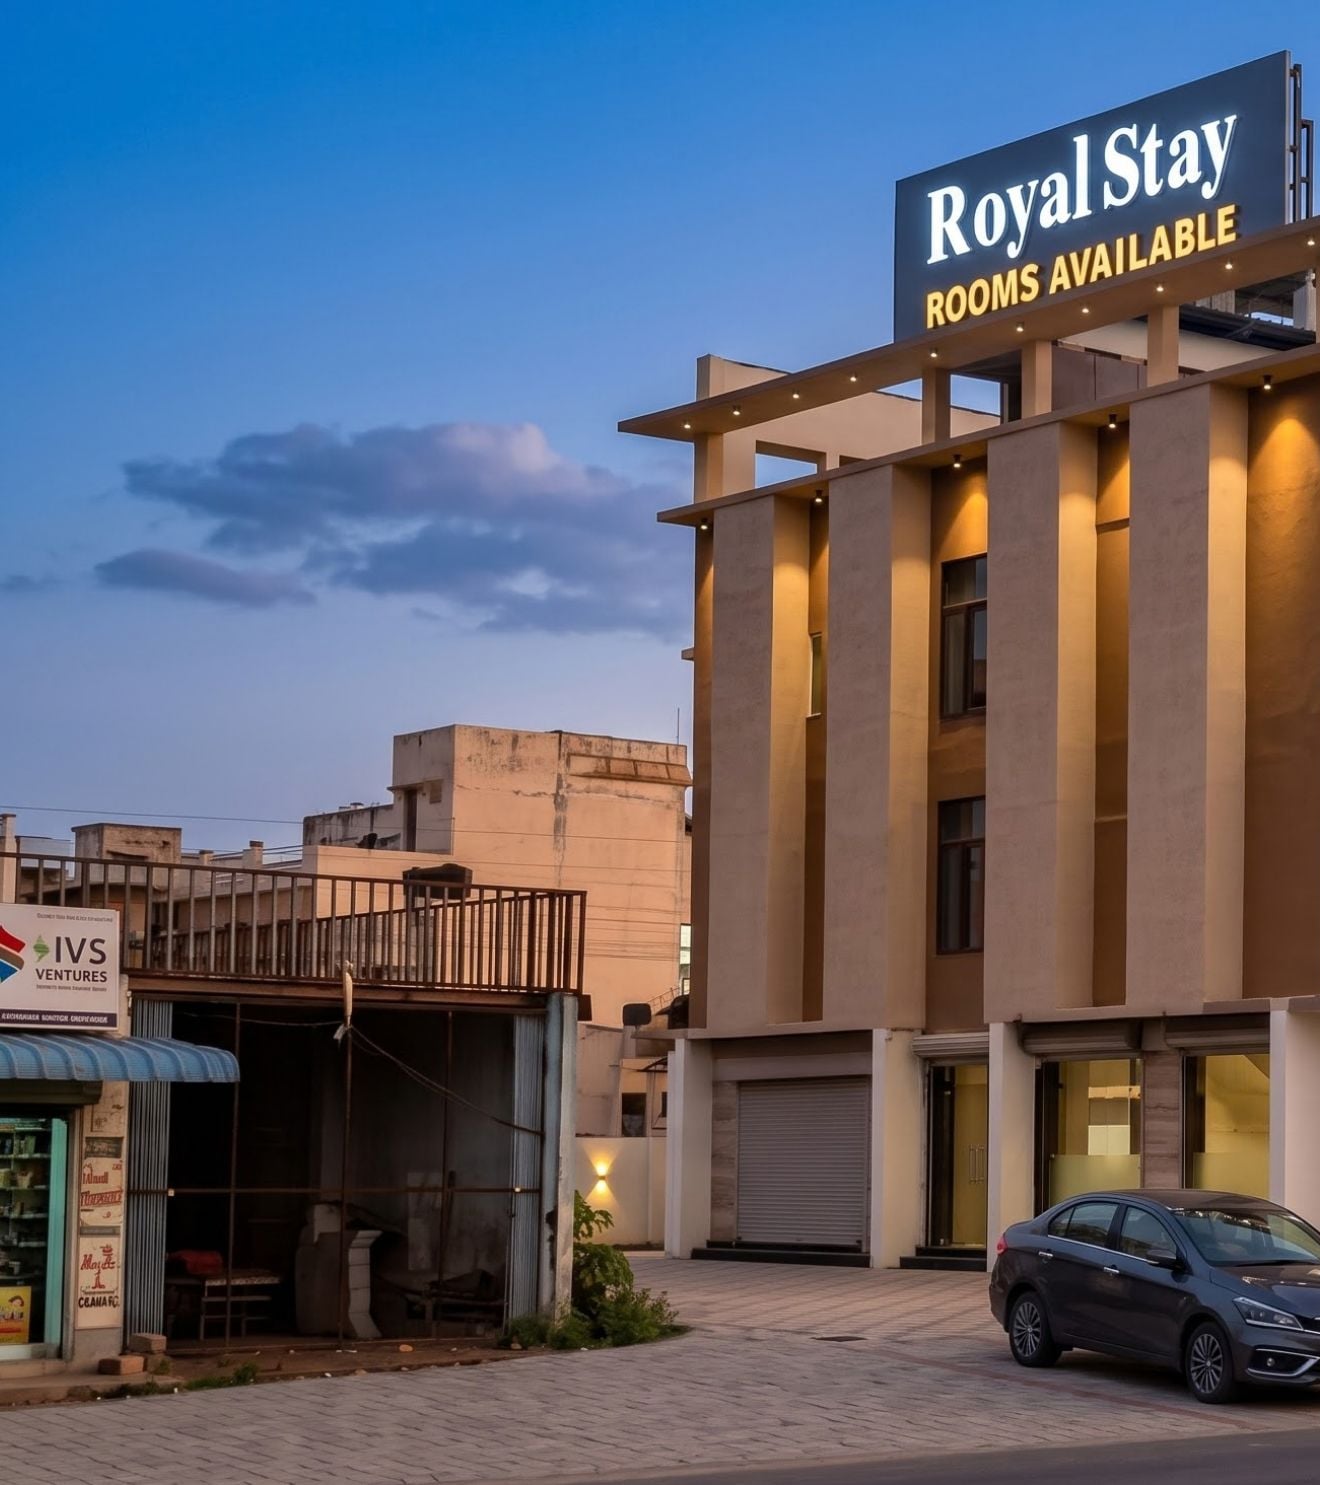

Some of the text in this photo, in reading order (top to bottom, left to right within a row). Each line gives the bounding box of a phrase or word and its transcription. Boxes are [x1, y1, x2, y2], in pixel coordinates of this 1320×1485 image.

[926, 114, 1238, 264] Royal Stay
[926, 203, 1237, 329] ROOMS AVAILABLE
[35, 968, 108, 983] VENTURES
[55, 936, 107, 965] IVS
